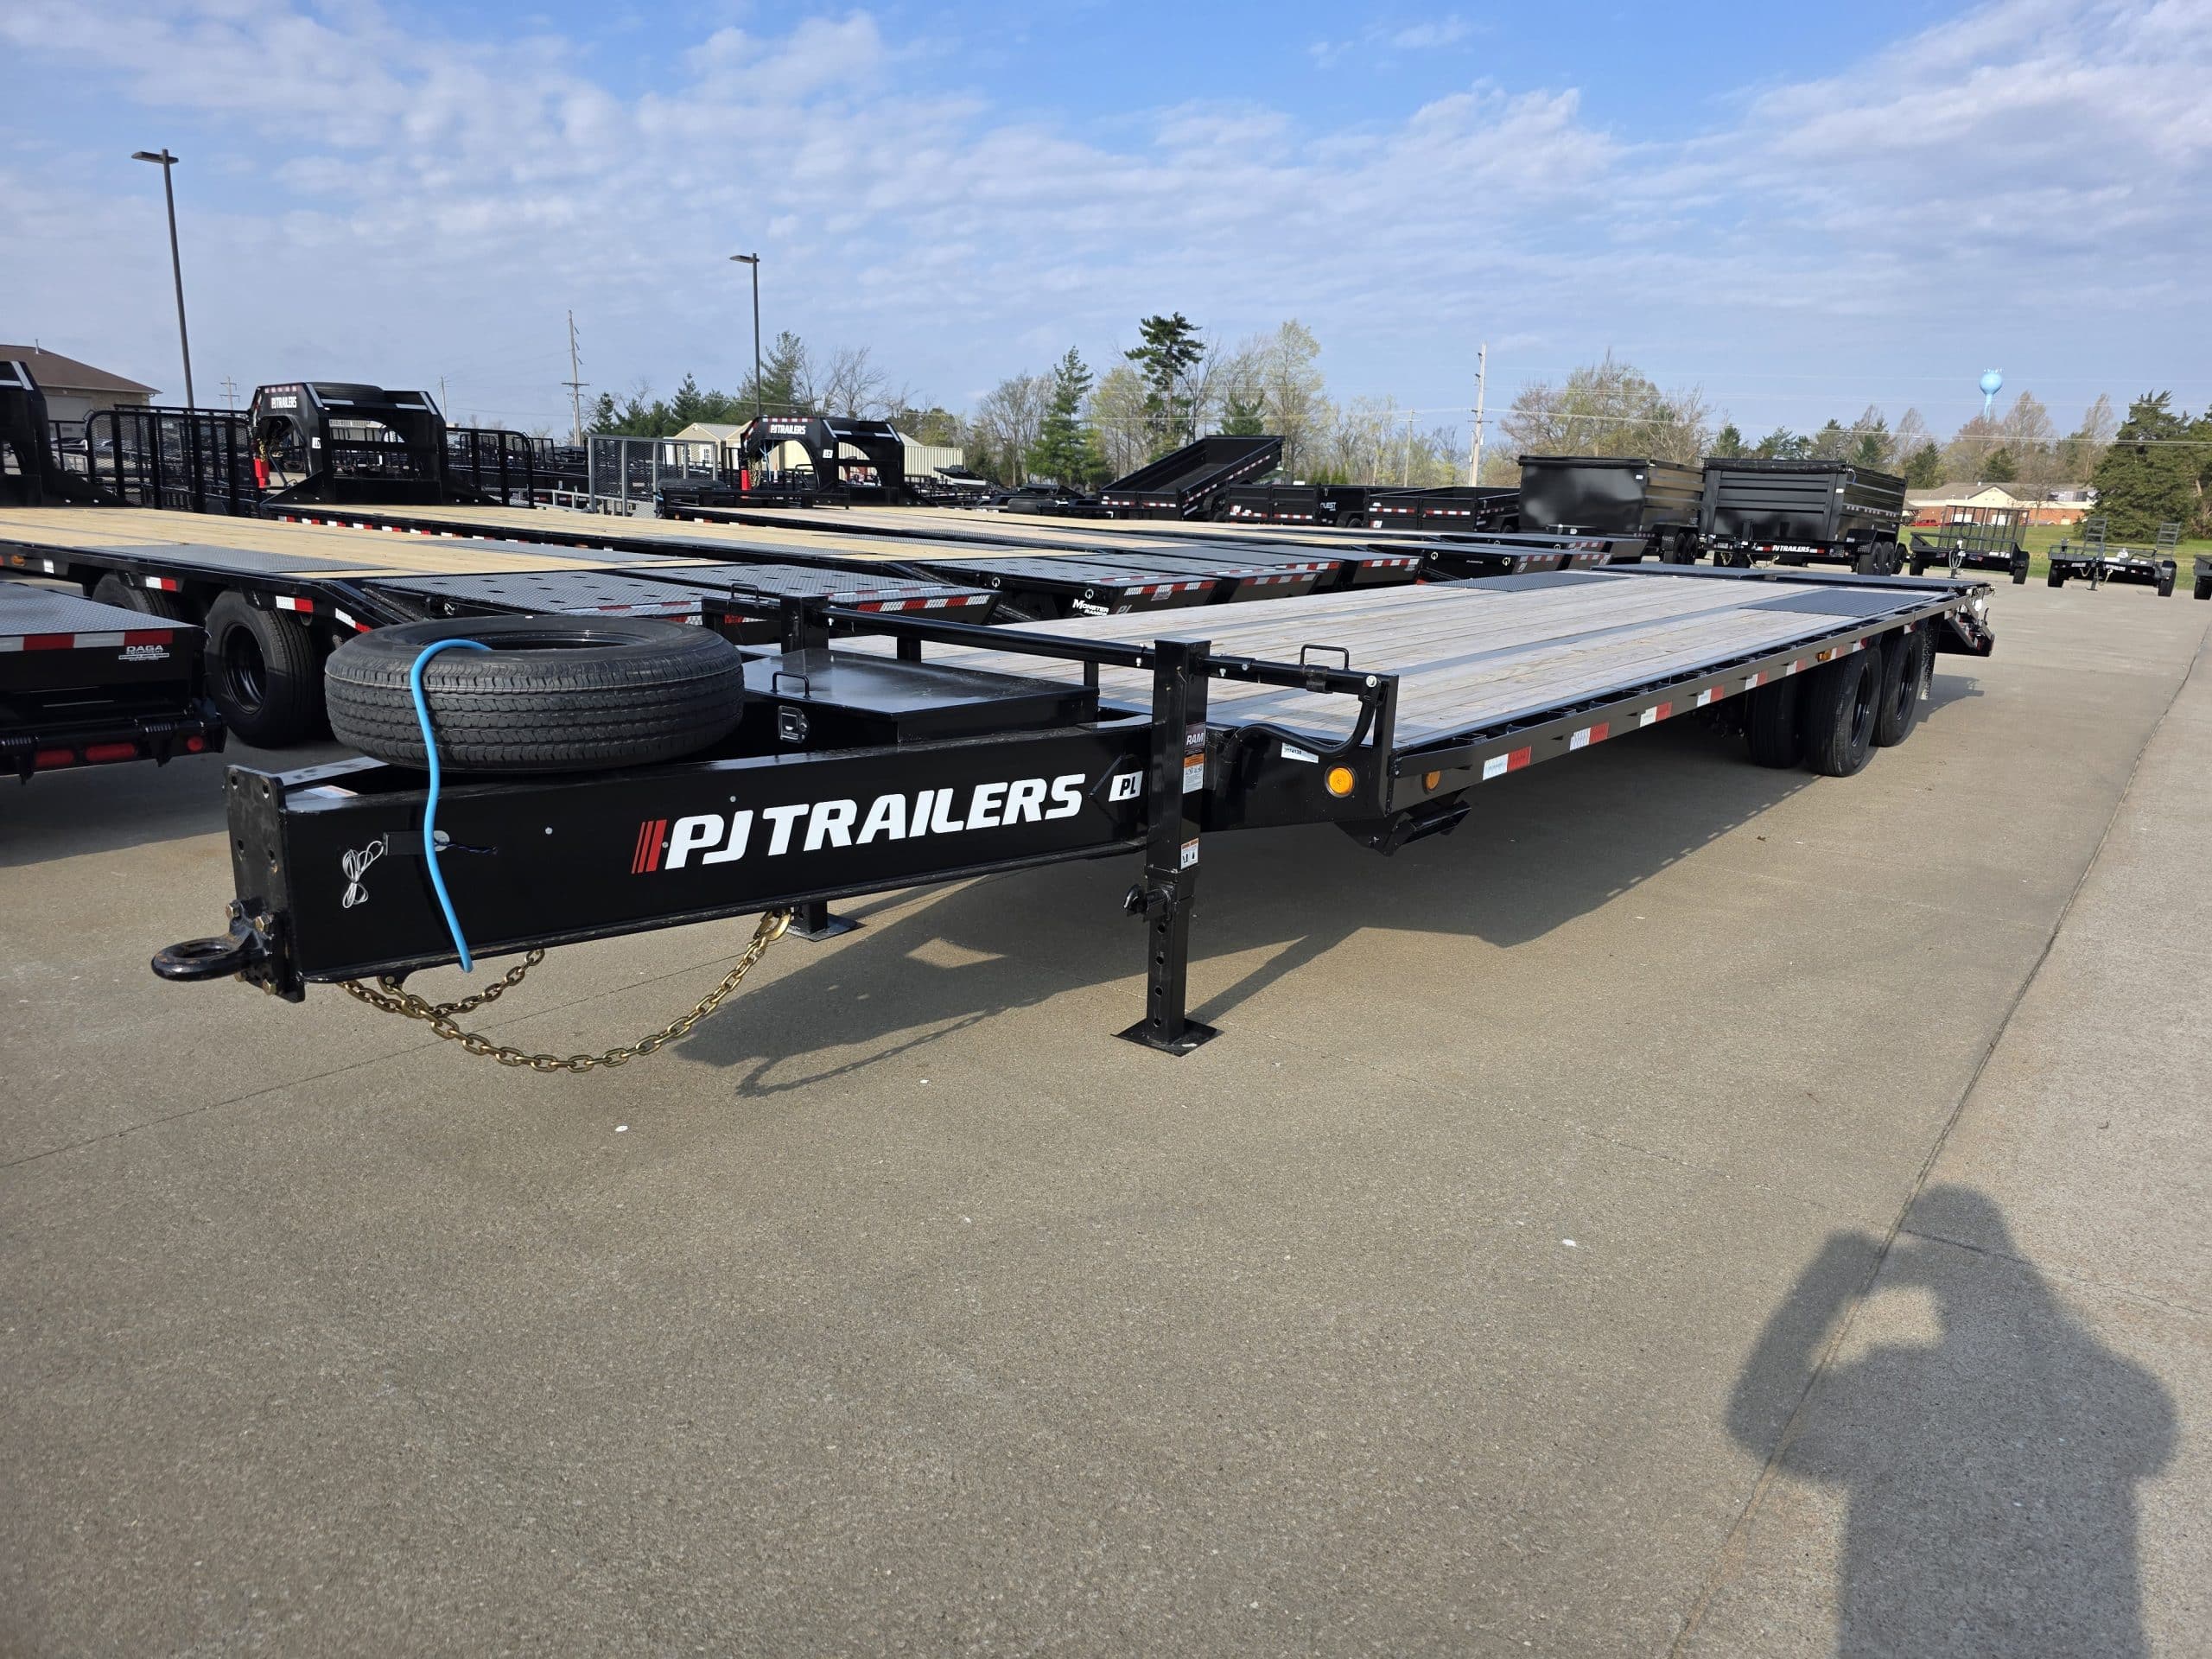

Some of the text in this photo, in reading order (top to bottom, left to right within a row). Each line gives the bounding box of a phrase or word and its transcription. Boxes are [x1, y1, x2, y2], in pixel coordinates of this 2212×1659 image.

[778, 424, 807, 435] TRAILERS
[1185, 732, 1205, 746] RAM
[1119, 776, 1136, 796] PL
[761, 773, 1086, 856] TRAILERS
